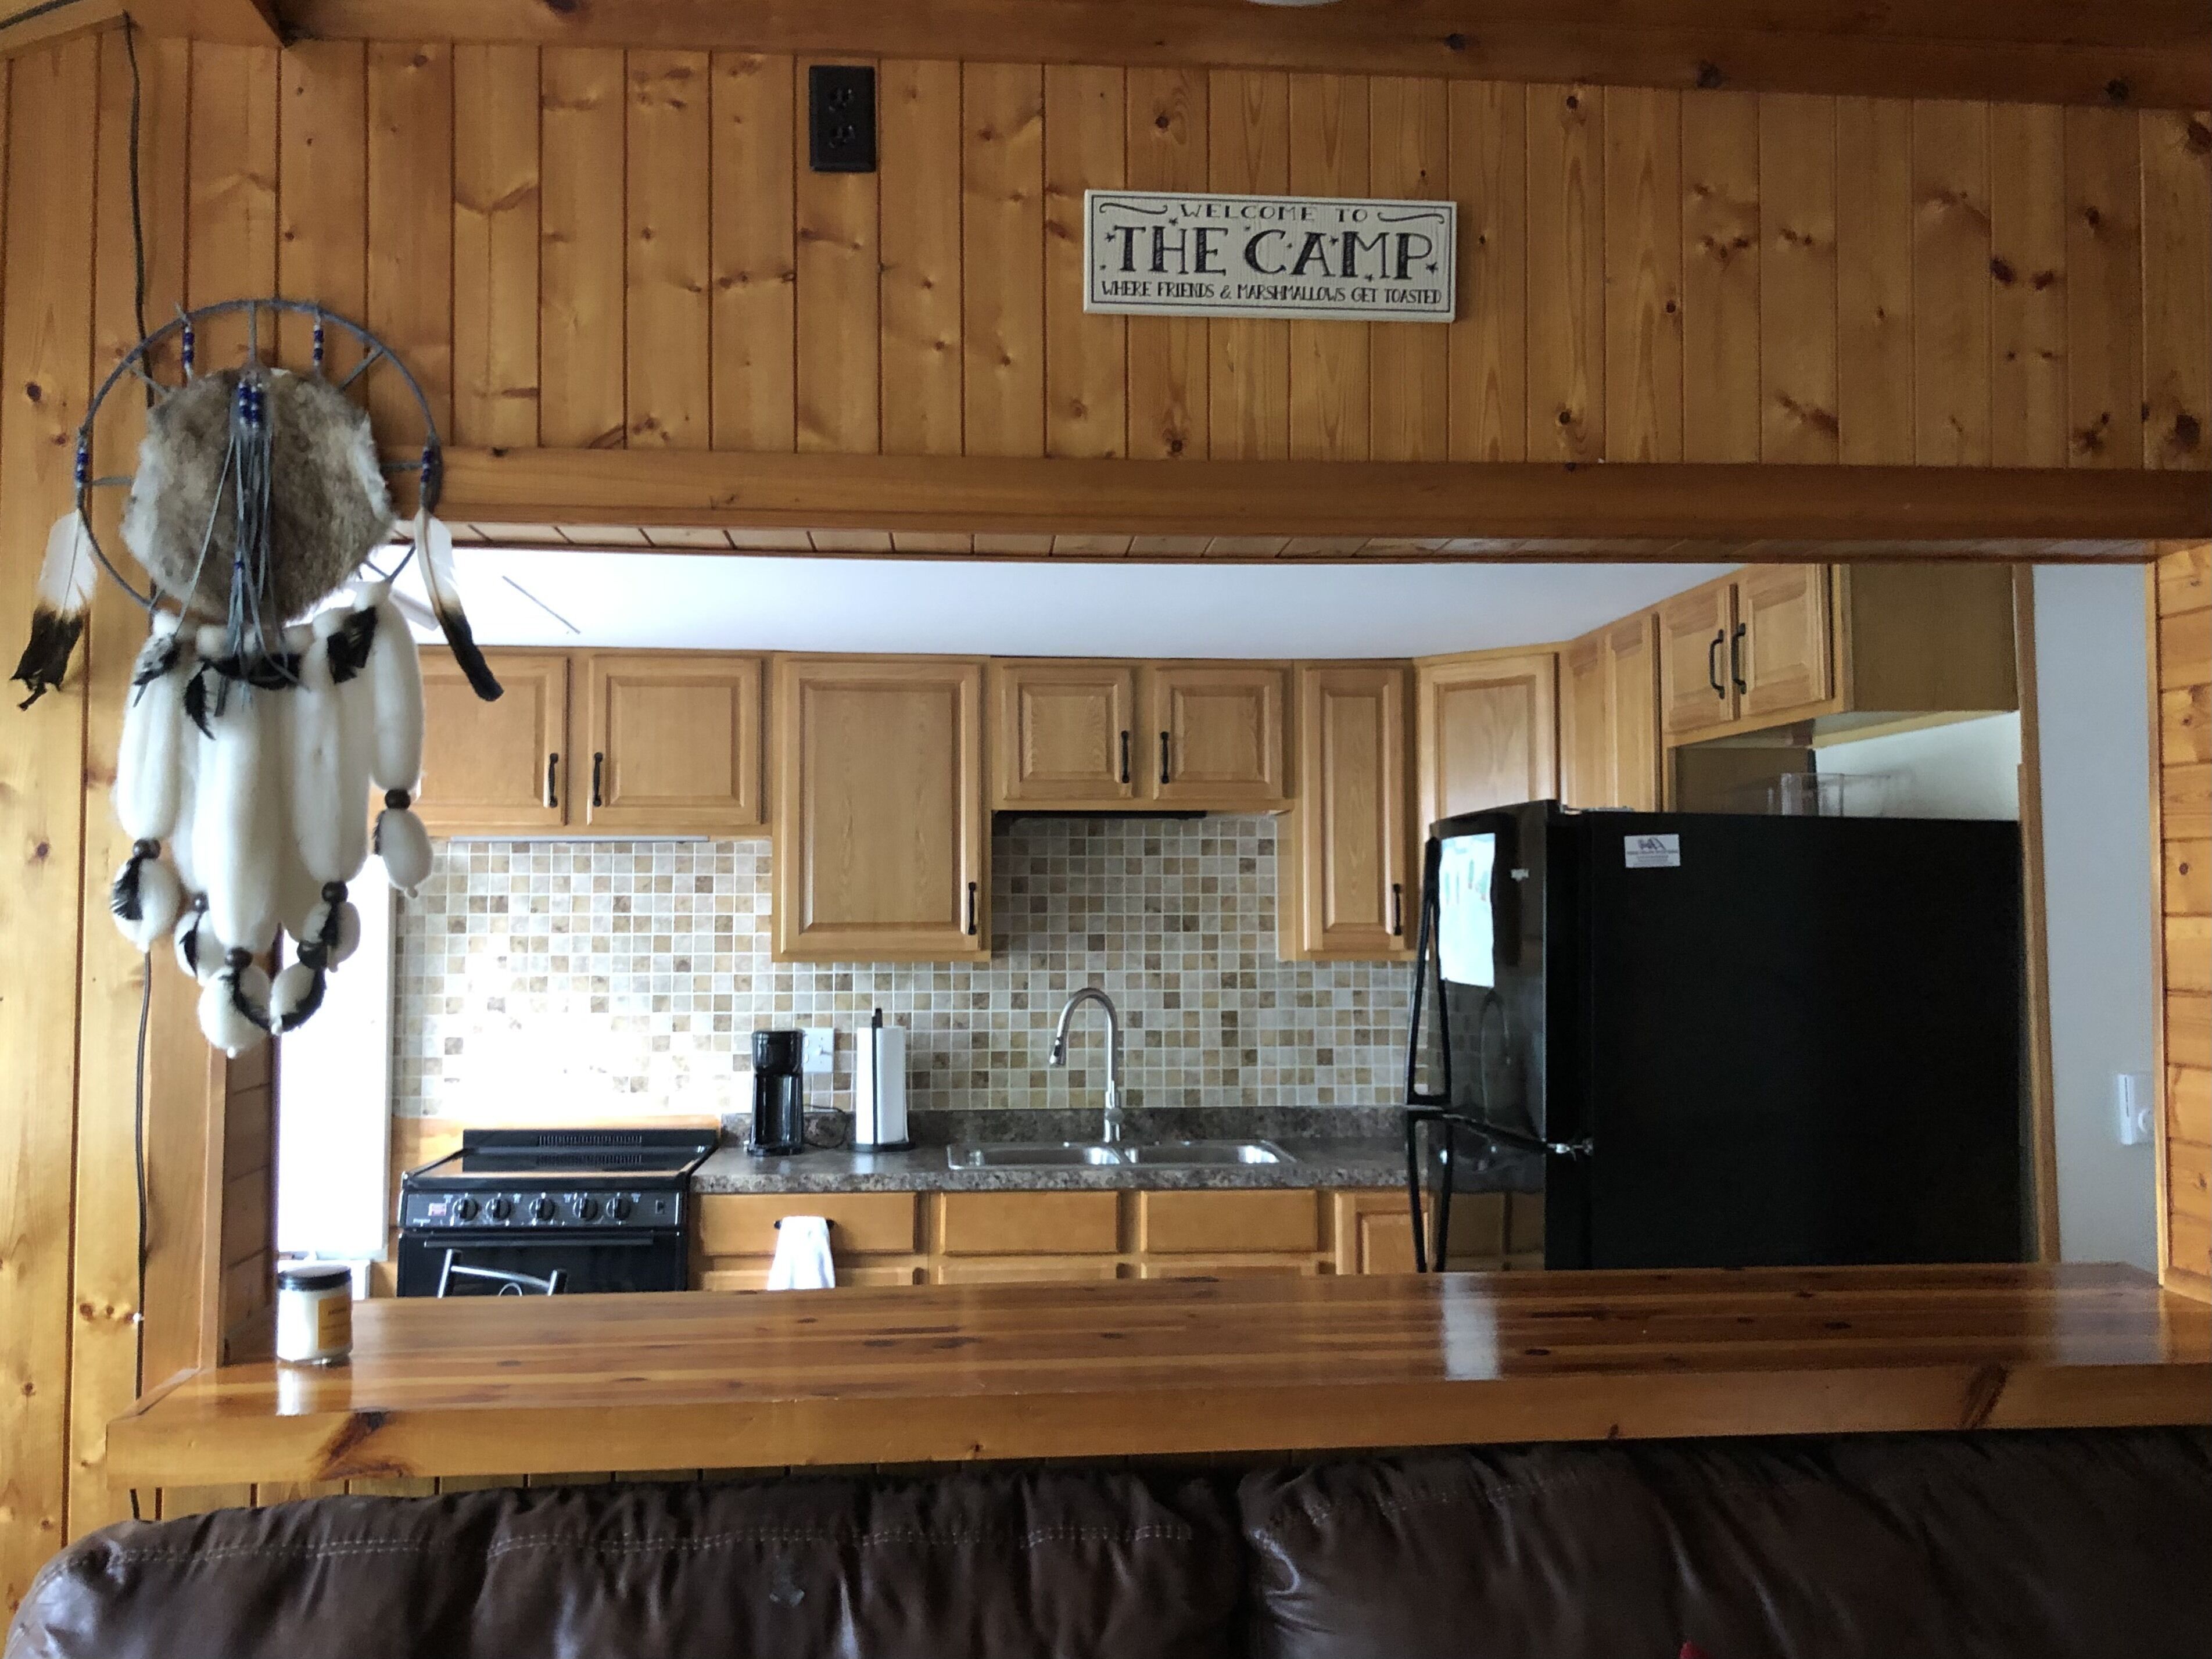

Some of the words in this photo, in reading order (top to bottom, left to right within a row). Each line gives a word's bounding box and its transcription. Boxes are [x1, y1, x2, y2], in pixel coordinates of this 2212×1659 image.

[1180, 203, 1315, 222] WELCOME
[1336, 209, 1368, 223] TO
[1113, 225, 1228, 276] THE
[1244, 228, 1433, 280] CAMP
[1102, 280, 1152, 297] WHERE
[1157, 281, 1215, 299] FRIENDS
[1220, 285, 1232, 300] &
[1237, 284, 1346, 302] MARSHMALLOWS
[1351, 286, 1378, 303] GET
[1384, 288, 1443, 304] TOASTED
